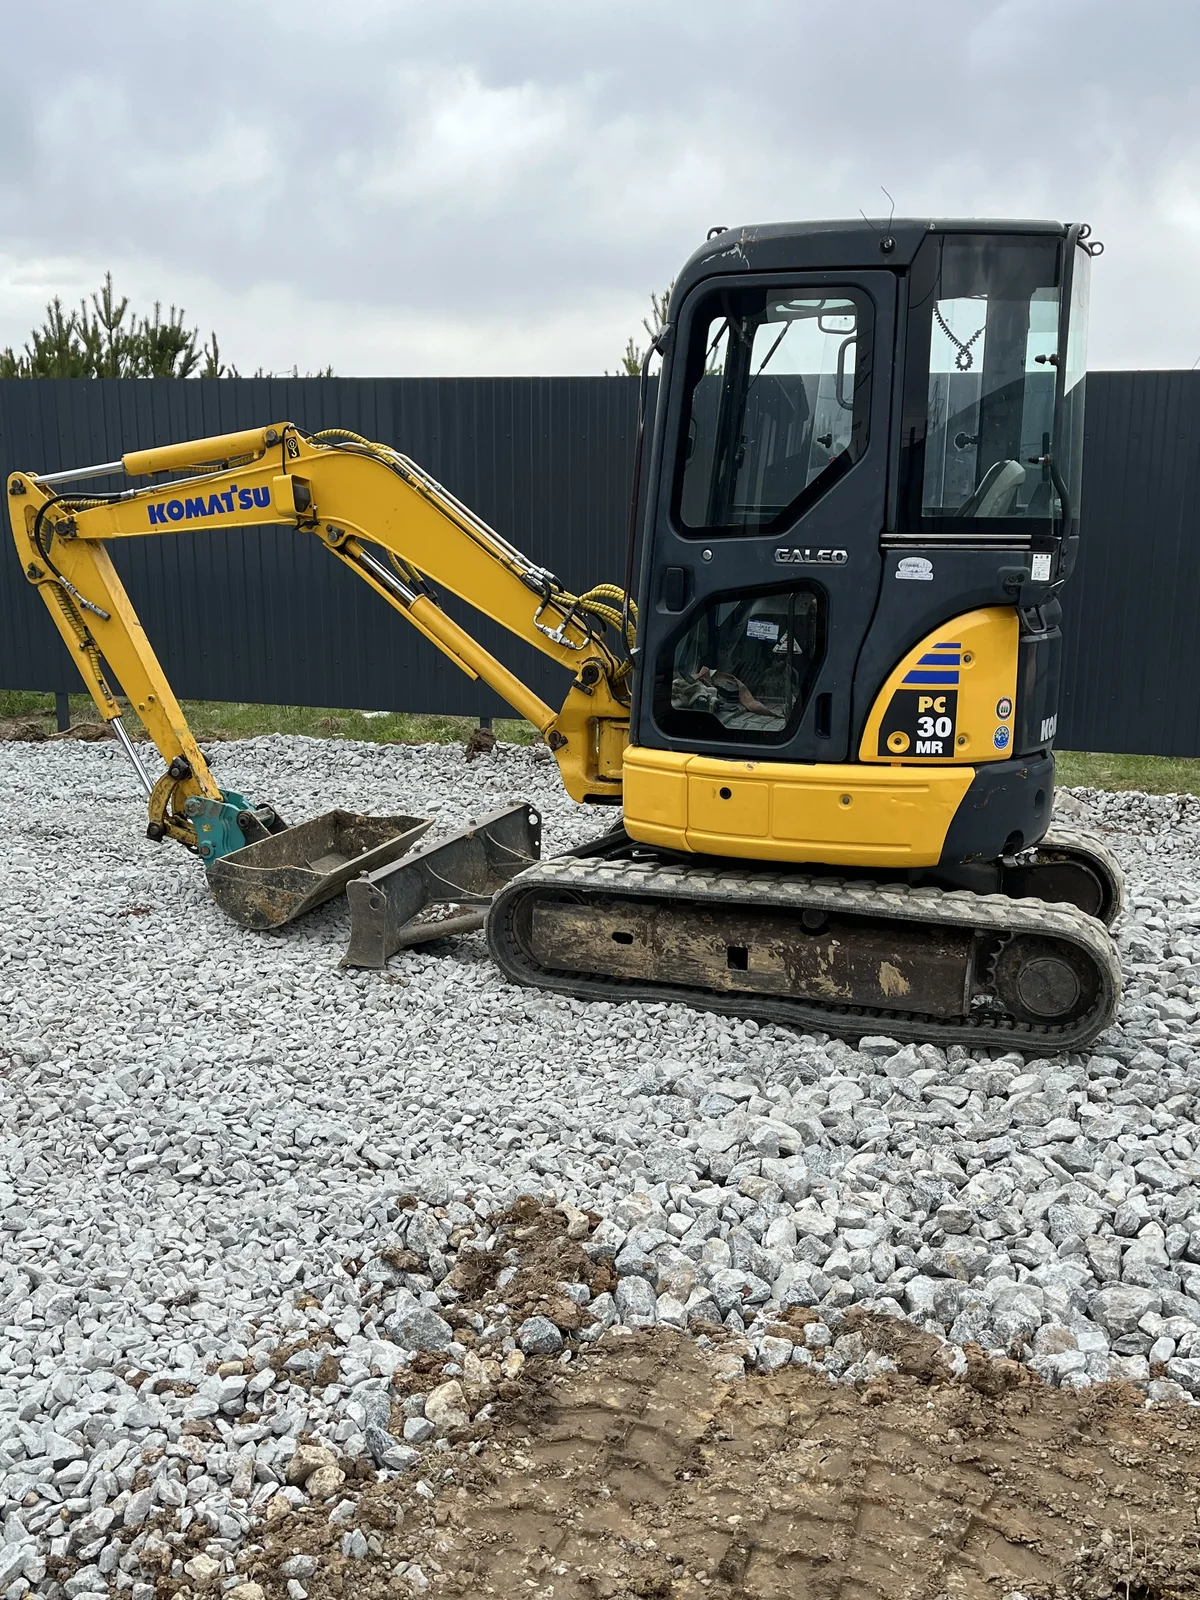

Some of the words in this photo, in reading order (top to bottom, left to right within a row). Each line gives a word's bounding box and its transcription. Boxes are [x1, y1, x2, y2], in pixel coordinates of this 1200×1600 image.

[147, 484, 271, 525] KOMATSU
[774, 548, 848, 564] GALEO
[918, 696, 946, 713] PC
[916, 716, 952, 737] 30
[915, 740, 943, 754] MR
